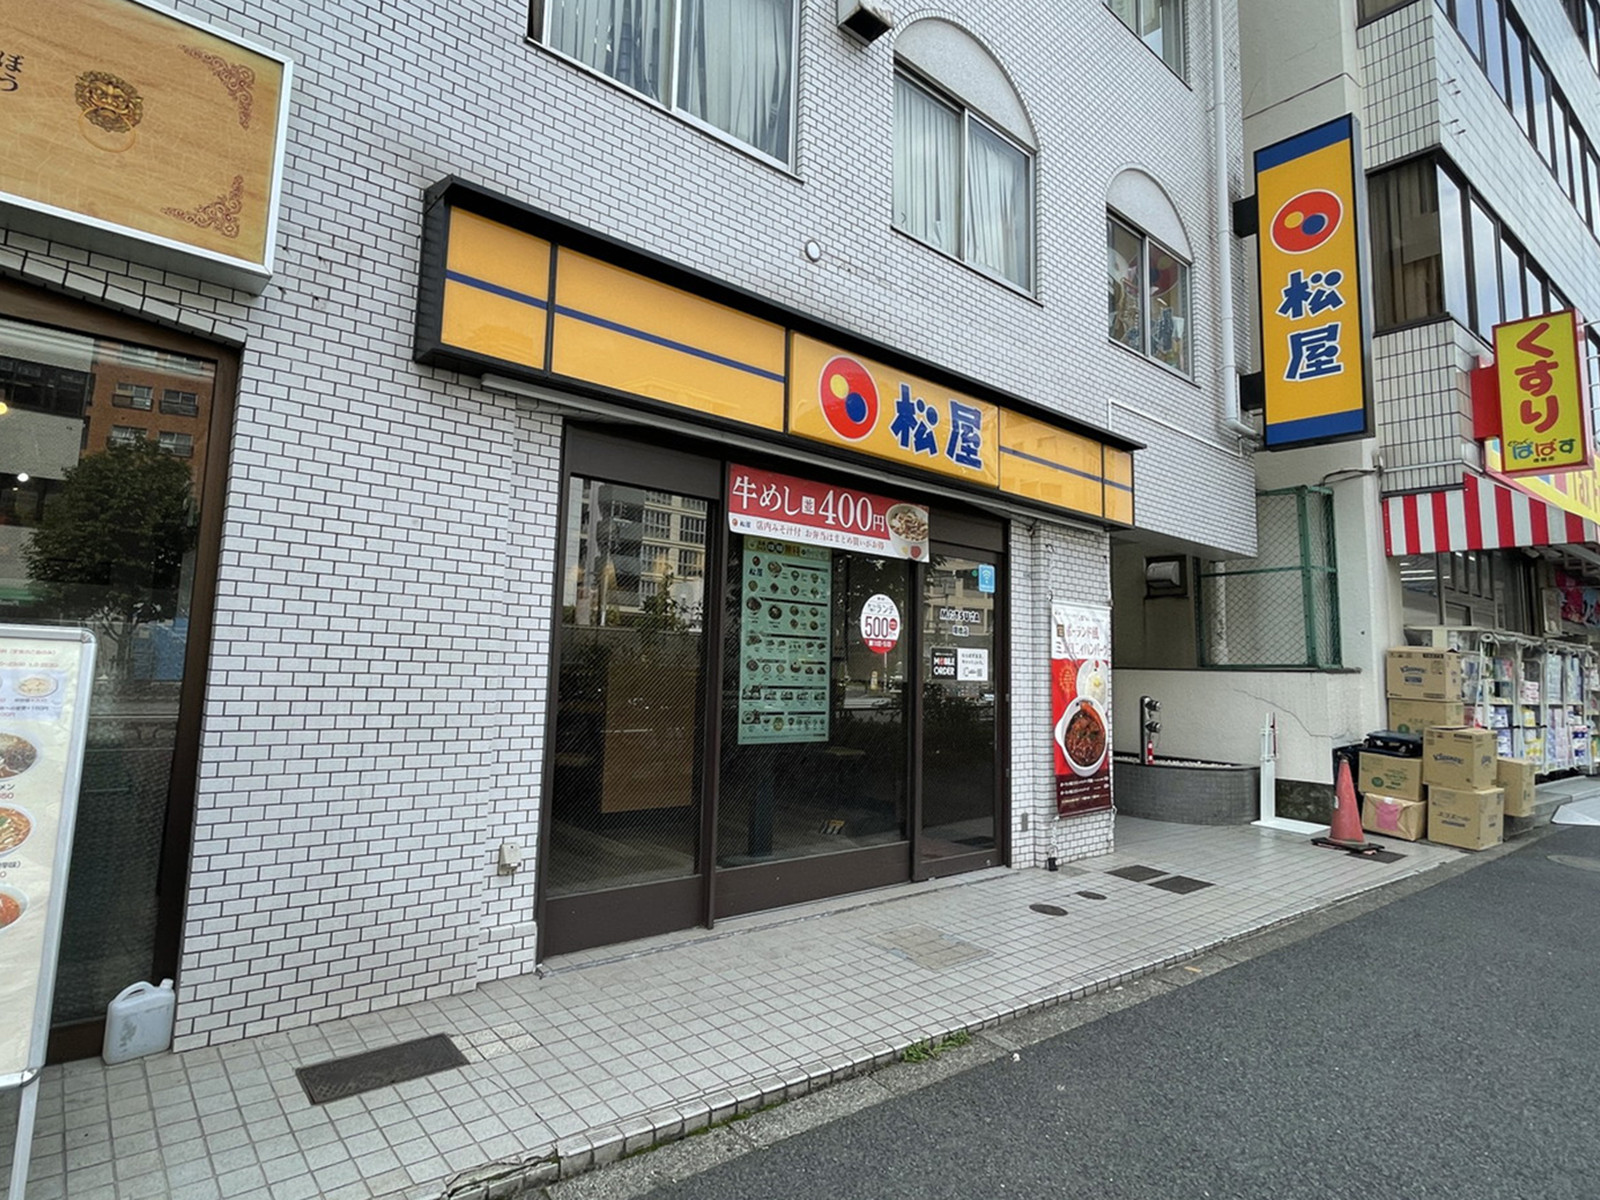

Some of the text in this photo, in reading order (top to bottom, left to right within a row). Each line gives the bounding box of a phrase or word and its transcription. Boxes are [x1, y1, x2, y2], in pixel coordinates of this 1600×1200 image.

[1276, 268, 1345, 382] 松屋
[1514, 321, 1560, 434] くすり
[888, 381, 984, 472] 松屋
